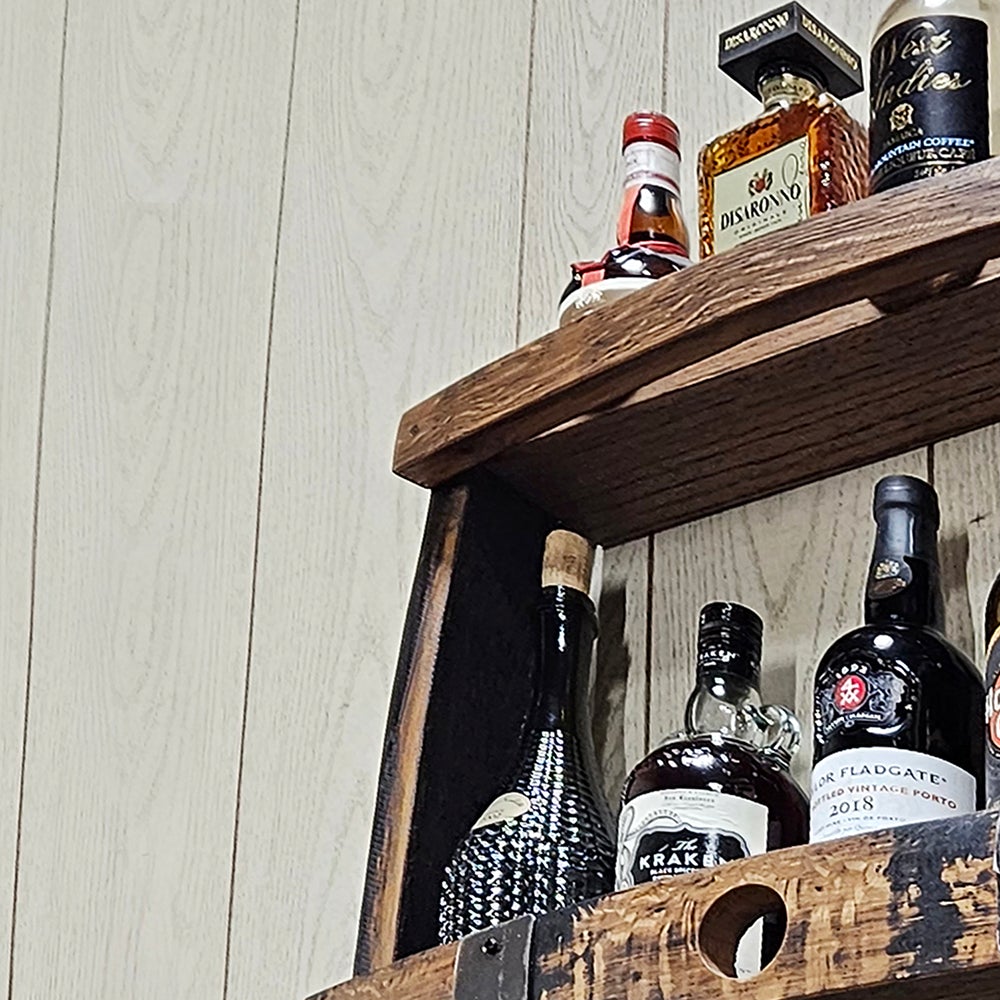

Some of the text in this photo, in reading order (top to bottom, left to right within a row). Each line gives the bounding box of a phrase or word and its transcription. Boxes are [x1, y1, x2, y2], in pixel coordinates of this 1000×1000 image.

[720, 183, 801, 231] DISARONNO
[840, 765, 941, 785] FLADGATE
[829, 795, 875, 818] 2018
[912, 789, 957, 810] PORTO
